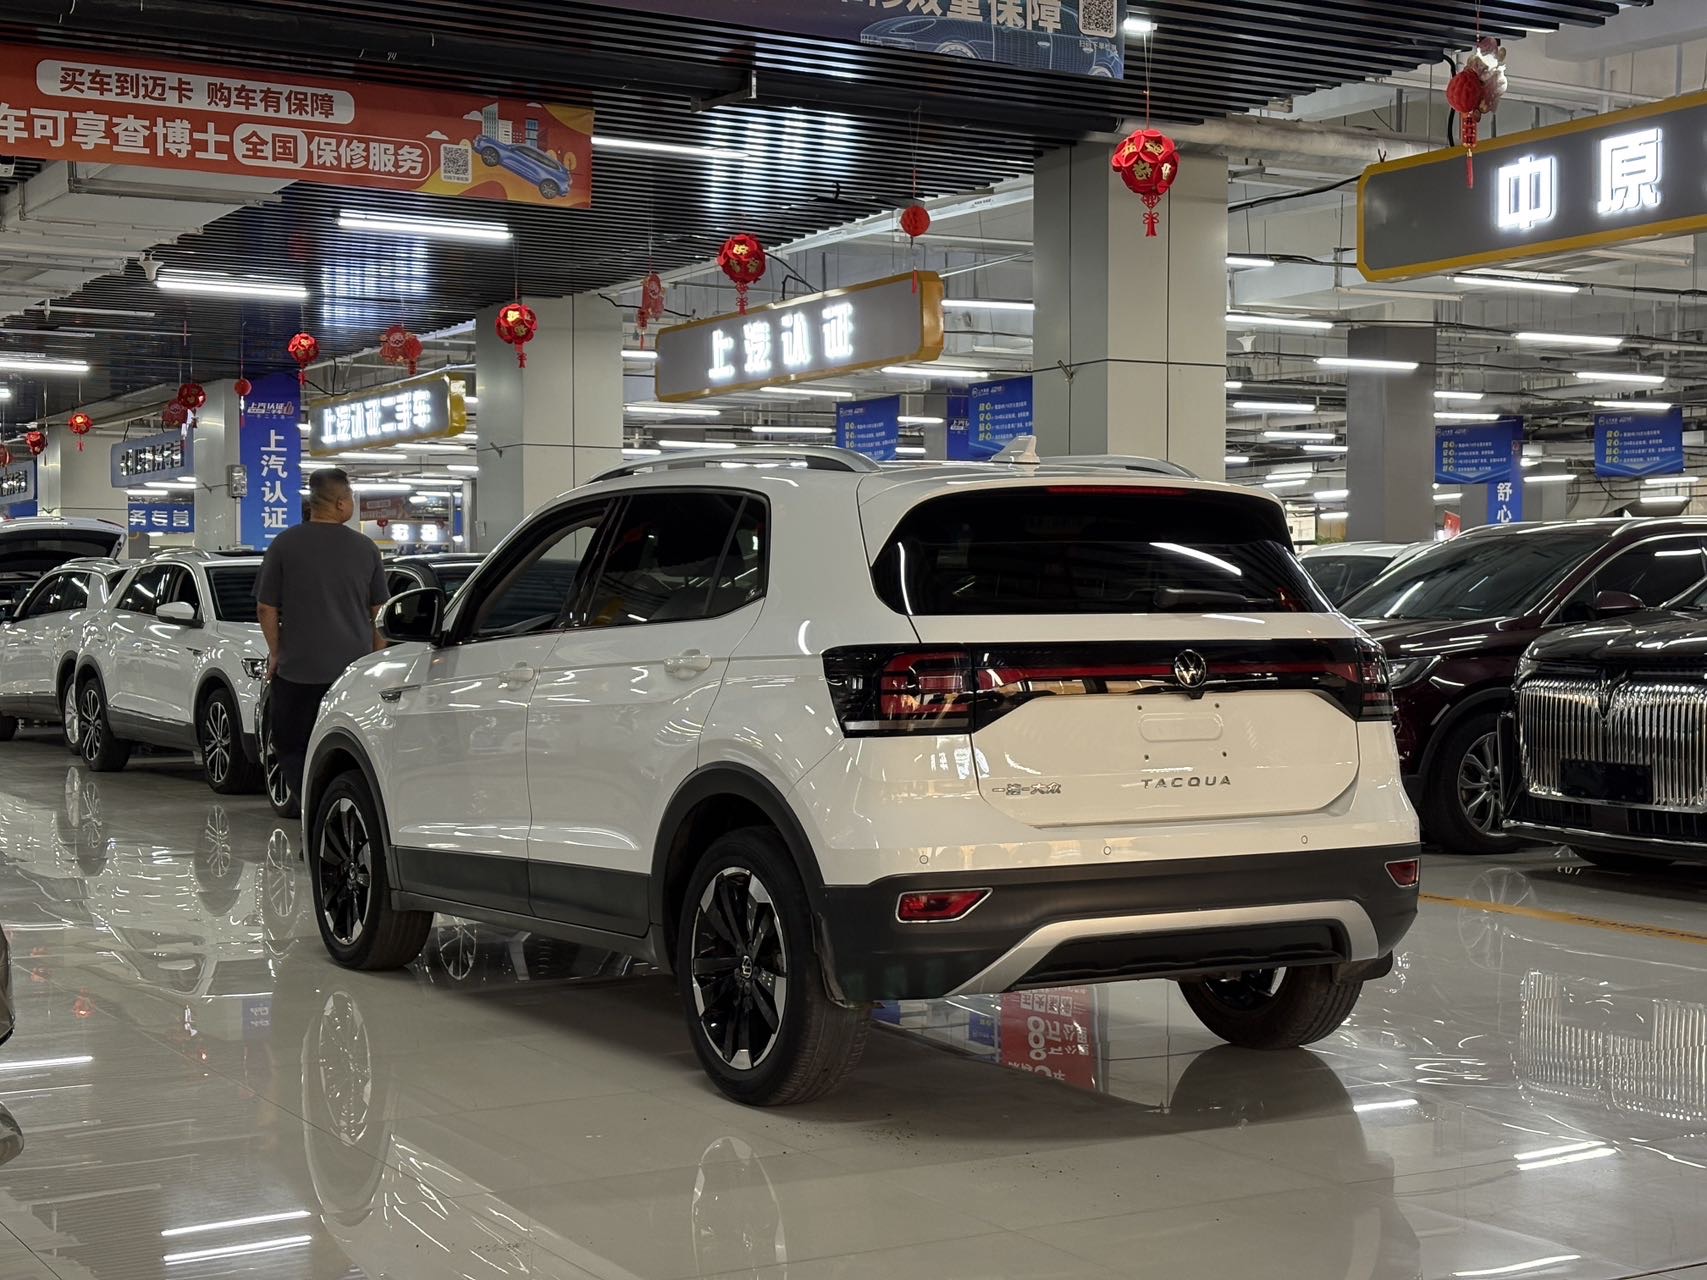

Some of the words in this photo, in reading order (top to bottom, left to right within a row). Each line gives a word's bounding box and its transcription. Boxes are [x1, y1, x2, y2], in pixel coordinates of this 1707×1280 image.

[59, 66, 194, 105] 买车到迈卡
[207, 81, 336, 119] 购车有保障
[1496, 127, 1664, 231] 中原
[708, 303, 854, 380] 上汽认证
[1496, 482, 1513, 523] 舒心
[1140, 775, 1232, 789] TACQUA
